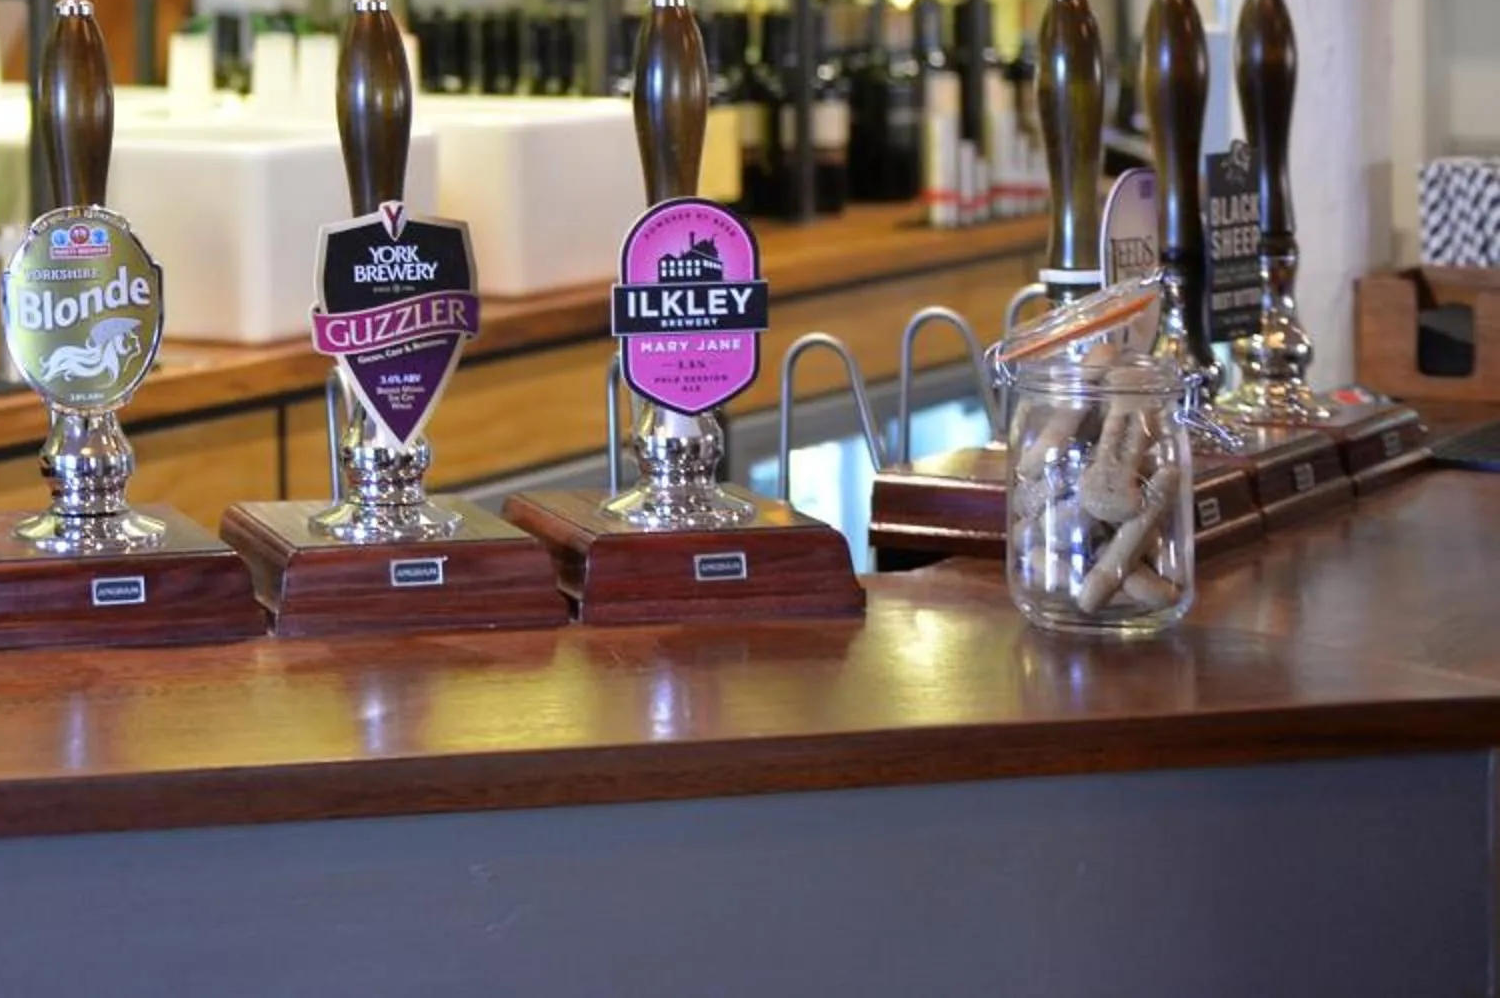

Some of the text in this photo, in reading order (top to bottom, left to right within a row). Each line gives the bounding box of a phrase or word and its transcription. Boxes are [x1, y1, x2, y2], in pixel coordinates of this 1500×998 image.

[368, 245, 419, 265] YORK
[353, 263, 439, 283] BREWERY
[18, 265, 151, 330] Blonde
[627, 288, 753, 318] ILKLEY
[325, 299, 470, 348] GUZZLER
[640, 337, 741, 352] MARY JANE
